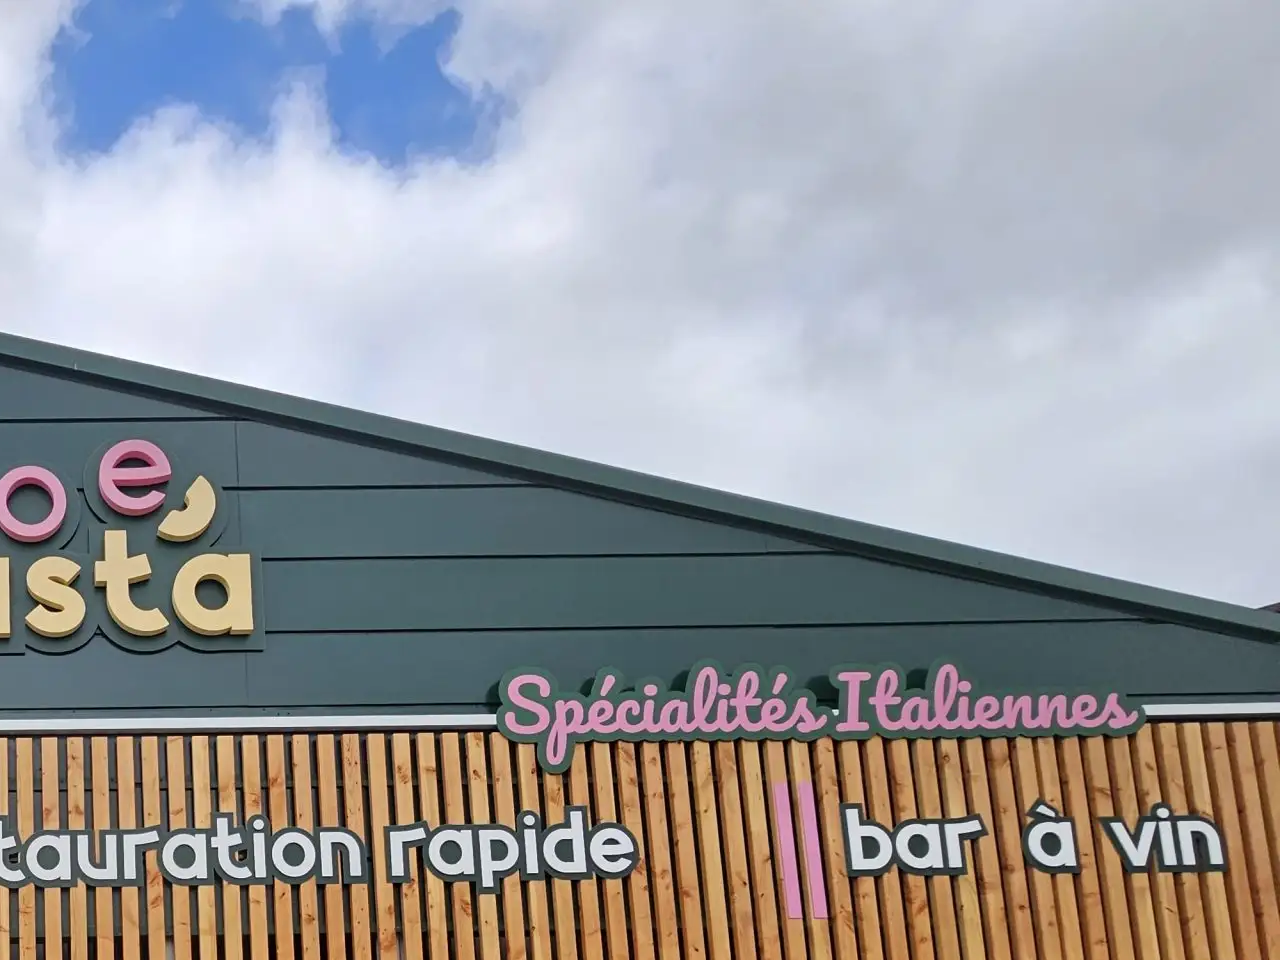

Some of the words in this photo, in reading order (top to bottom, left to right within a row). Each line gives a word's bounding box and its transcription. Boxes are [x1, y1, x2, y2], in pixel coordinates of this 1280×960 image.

[98, 438, 173, 517] e
[504, 664, 828, 766] Spécialités
[835, 662, 1138, 732] Italiennes
[388, 809, 635, 889] rapide
[844, 807, 983, 874] bar
[1027, 803, 1078, 869] à
[1109, 806, 1225, 869] vin
